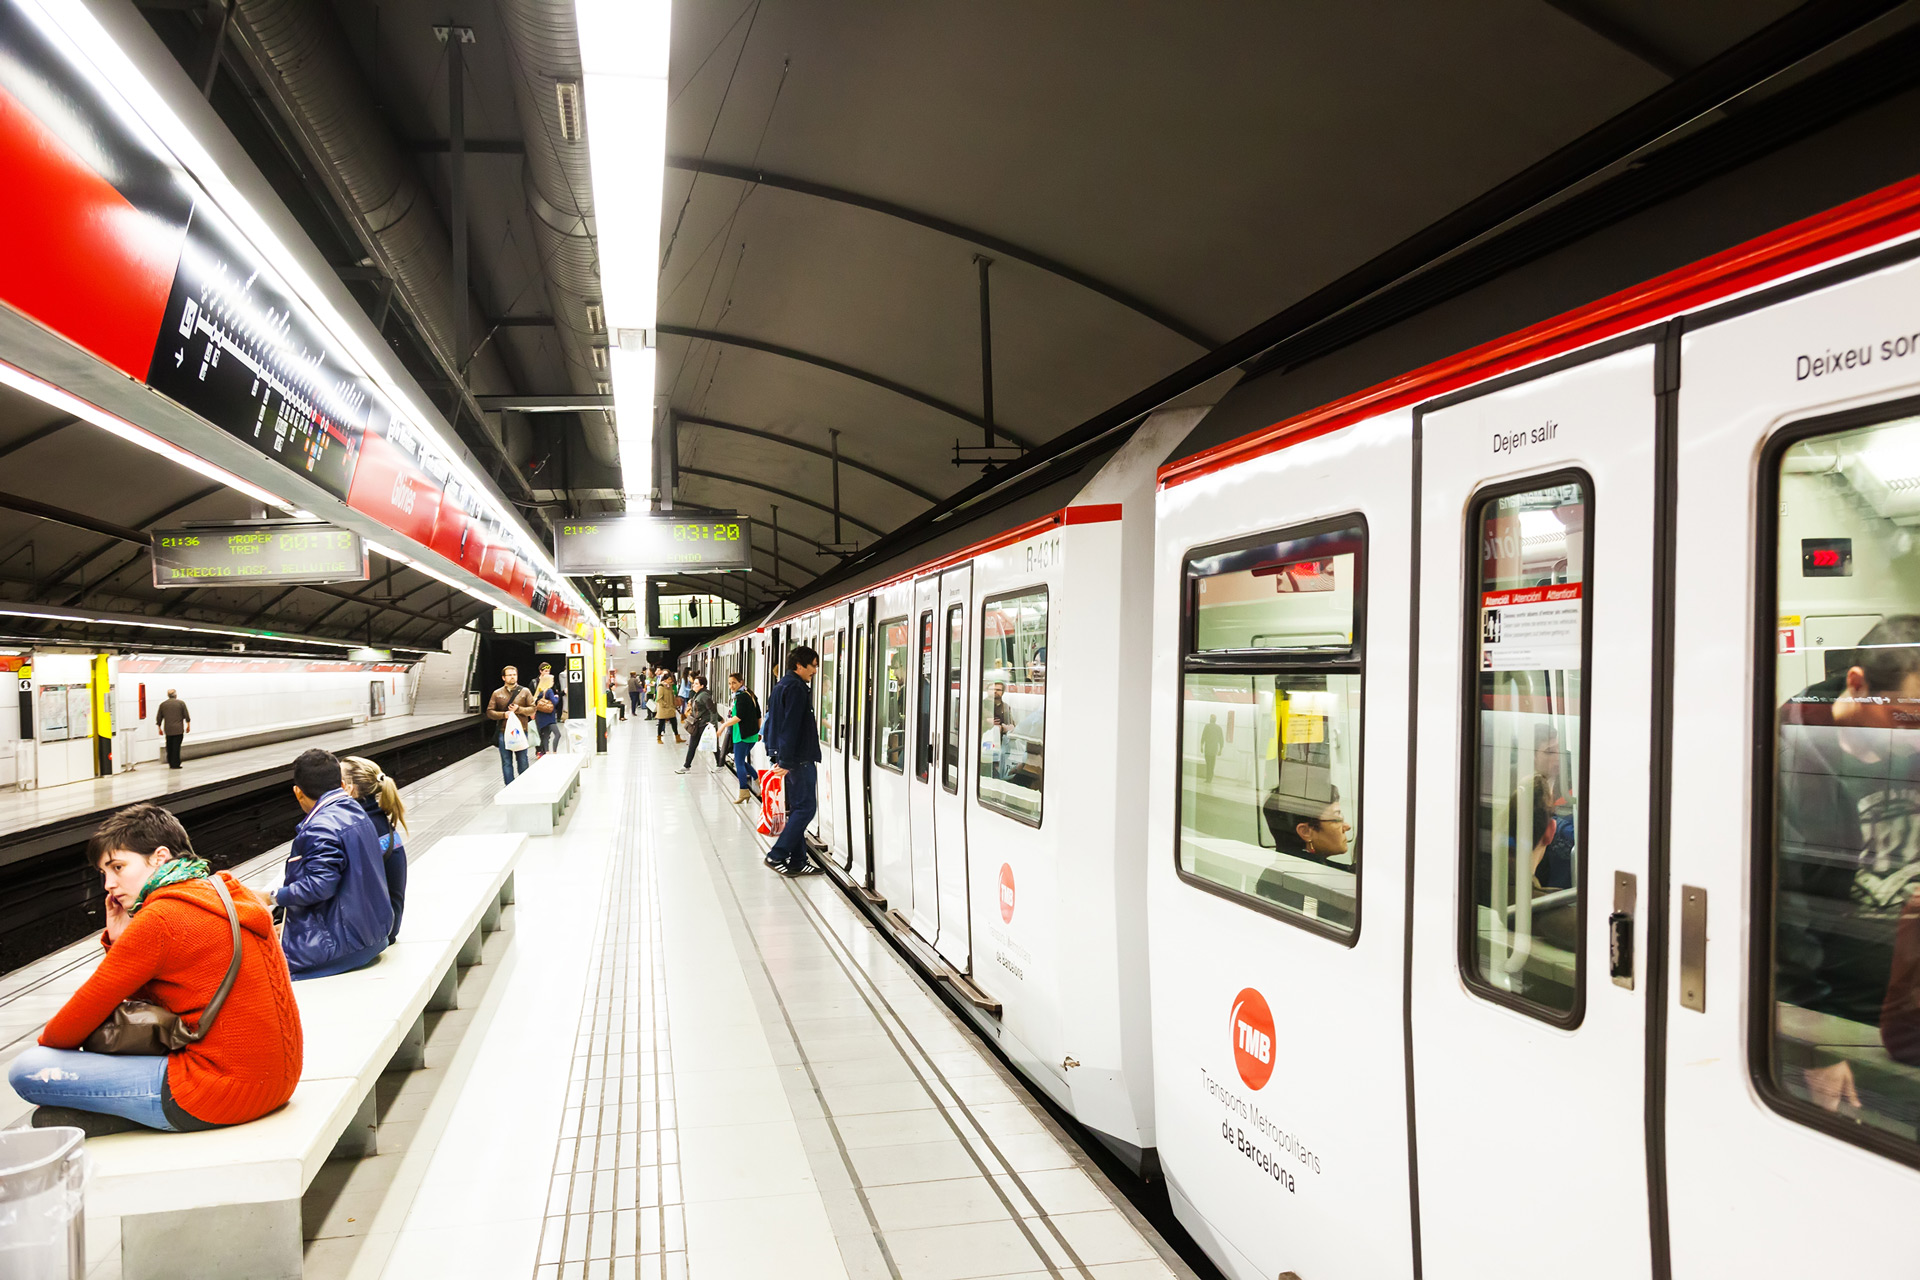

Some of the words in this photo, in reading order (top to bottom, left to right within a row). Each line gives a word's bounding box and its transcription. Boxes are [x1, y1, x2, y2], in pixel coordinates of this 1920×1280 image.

[1796, 345, 1872, 381] Deixeu
[1493, 431, 1527, 455] Dejen
[1531, 420, 1559, 445] salir
[162, 536, 200, 547] 21:36
[228, 534, 273, 544] PROPER
[280, 533, 352, 551] 00:18
[563, 525, 599, 535] 21:36
[673, 524, 740, 541] 03:20
[238, 565, 273, 576] HOSP.
[1026, 538, 1060, 573] R-4311
[1238, 1019, 1271, 1065] TMB
[1201, 1067, 1248, 1119] Transports
[1250, 1103, 1321, 1175] Metropolitans
[1222, 1118, 1234, 1145] de
[1237, 1128, 1296, 1195] Barcelona
